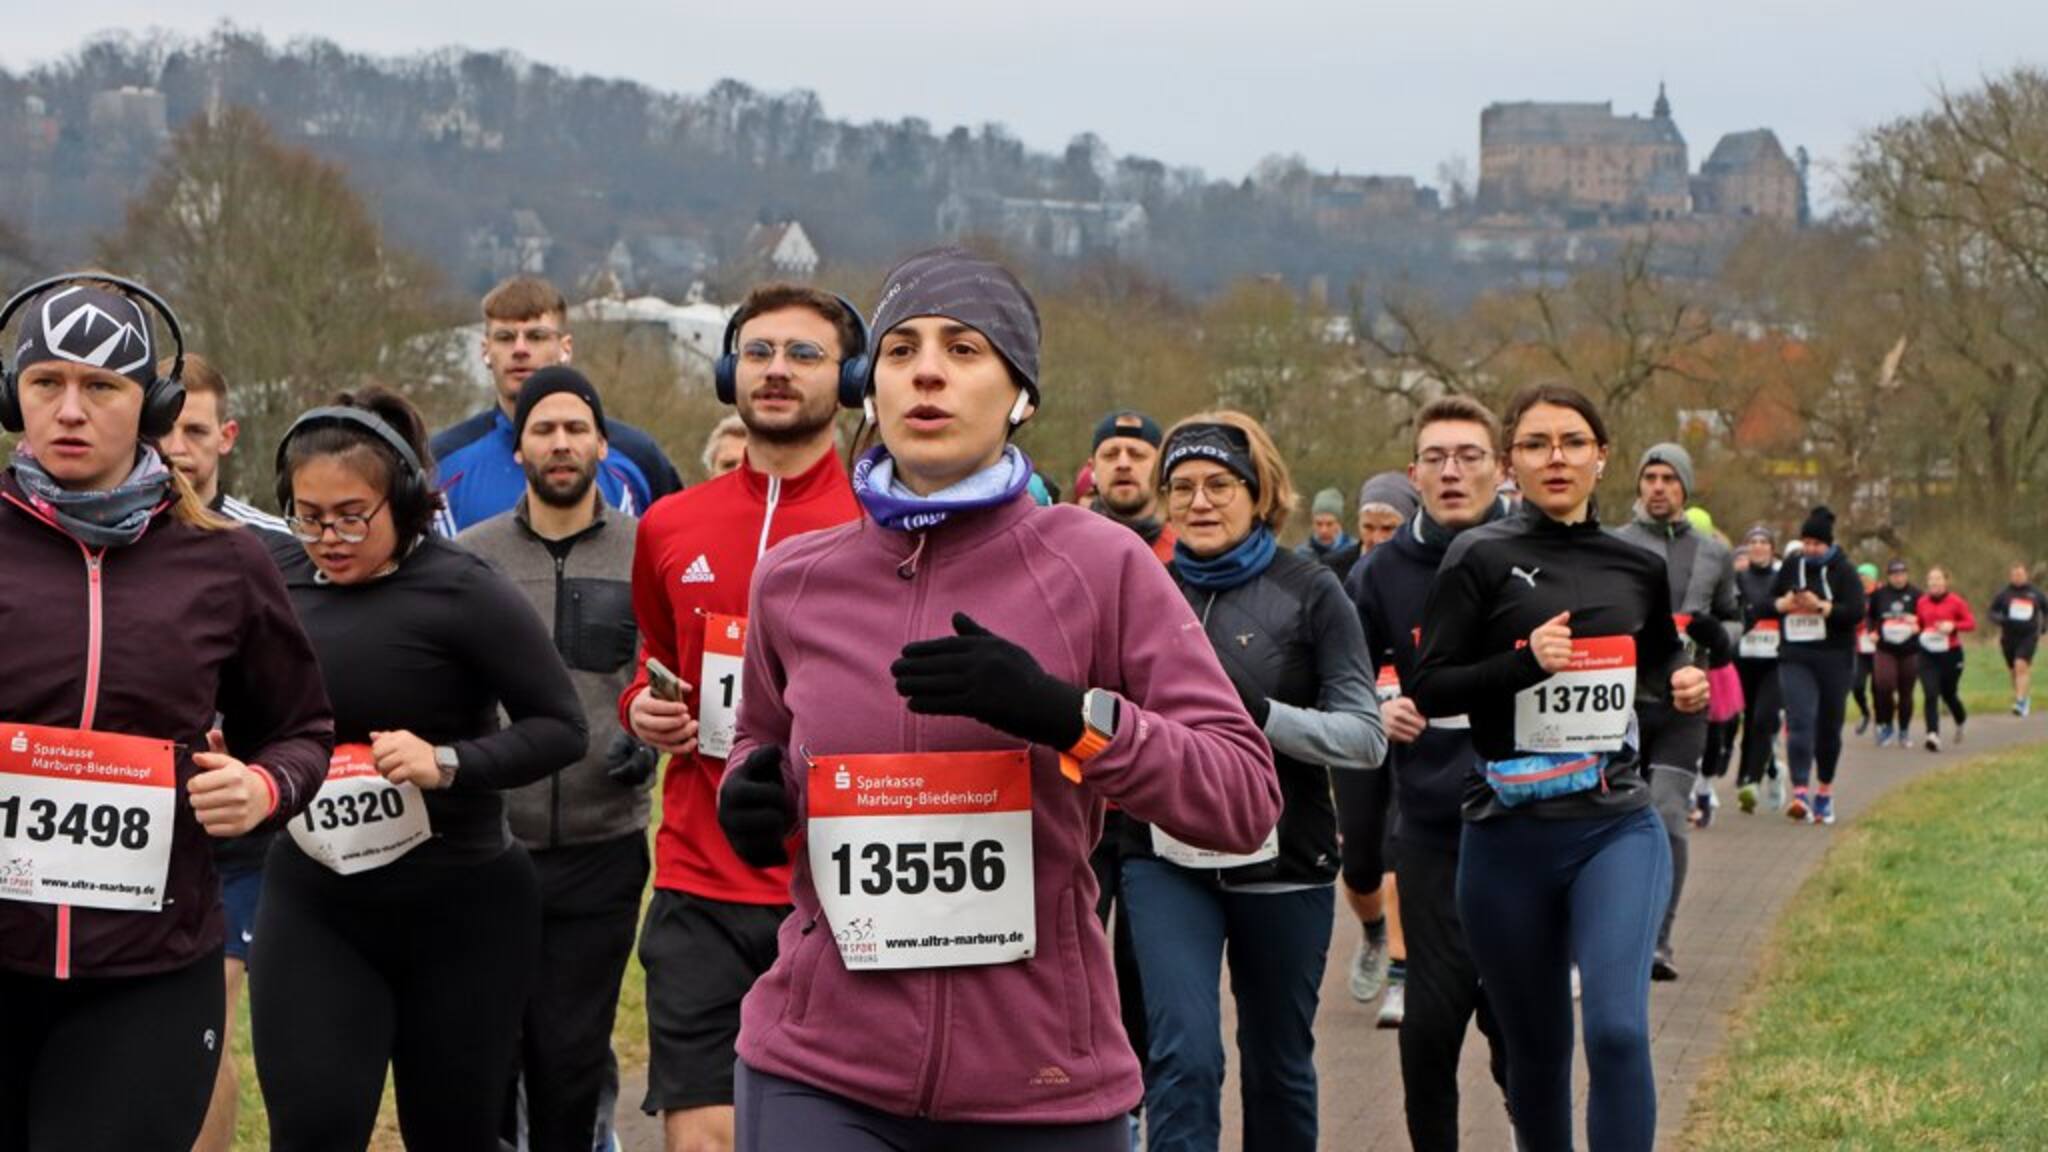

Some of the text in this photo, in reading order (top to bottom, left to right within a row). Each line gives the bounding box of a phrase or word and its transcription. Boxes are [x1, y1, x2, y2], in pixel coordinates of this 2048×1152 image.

[1534, 683, 1625, 715] 13780
[33, 742, 94, 760] Sparkasse
[31, 757, 152, 779] Marburg-Biedenkopf
[857, 775, 925, 791] Sparkasse
[857, 790, 998, 808] Marburg-Biedenkopf
[303, 787, 405, 833] 13320
[0, 796, 150, 851] 13498
[832, 840, 1006, 895] 13556
[41, 876, 155, 896] www.ultra-marburg.de
[886, 931, 1024, 949] www.ultra-marburg.de
